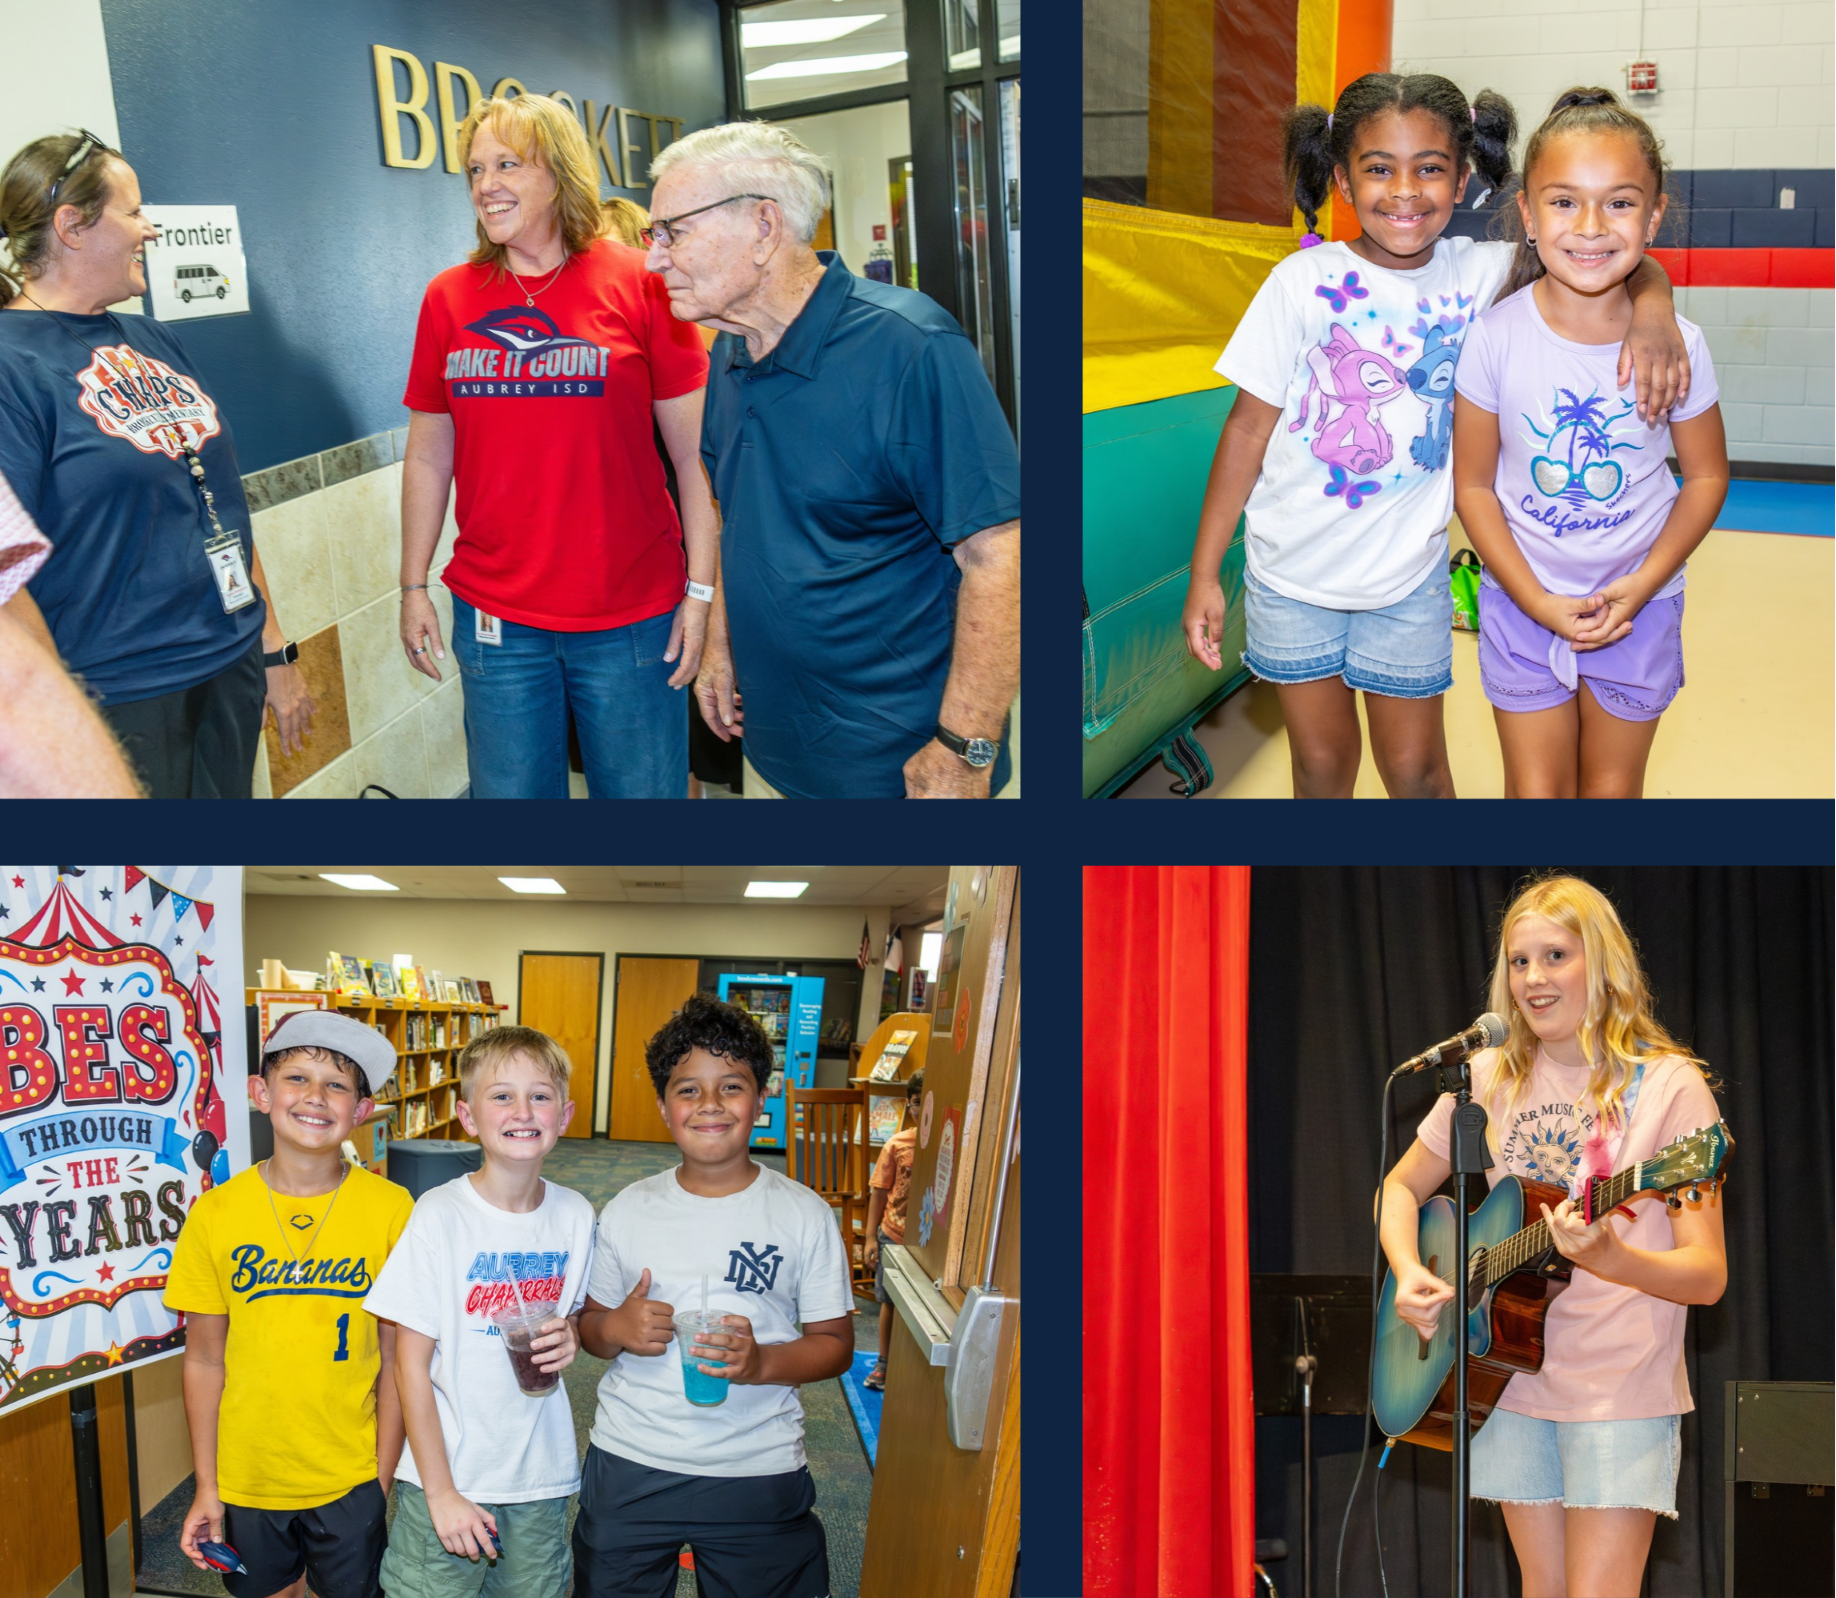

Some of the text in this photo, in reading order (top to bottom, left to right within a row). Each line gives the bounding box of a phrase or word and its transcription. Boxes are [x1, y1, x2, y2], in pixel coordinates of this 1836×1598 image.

[152, 221, 232, 247] Frontier
[445, 347, 611, 380] MAKE IT COUNT
[97, 375, 196, 421] CHAPS
[461, 383, 588, 395] AUBREY ISD
[1520, 494, 1636, 537] California
[0, 1003, 178, 1119] BES
[20, 1116, 152, 1158] THROUGH
[1503, 1110, 1539, 1163] SUMMER
[1709, 1133, 1720, 1169] Ibanez
[67, 1157, 121, 1189] THE
[0, 1180, 187, 1270] YEARS
[231, 1244, 366, 1294] Bananas
[466, 1251, 569, 1282] AUBREY
[334, 1313, 350, 1362] 1
